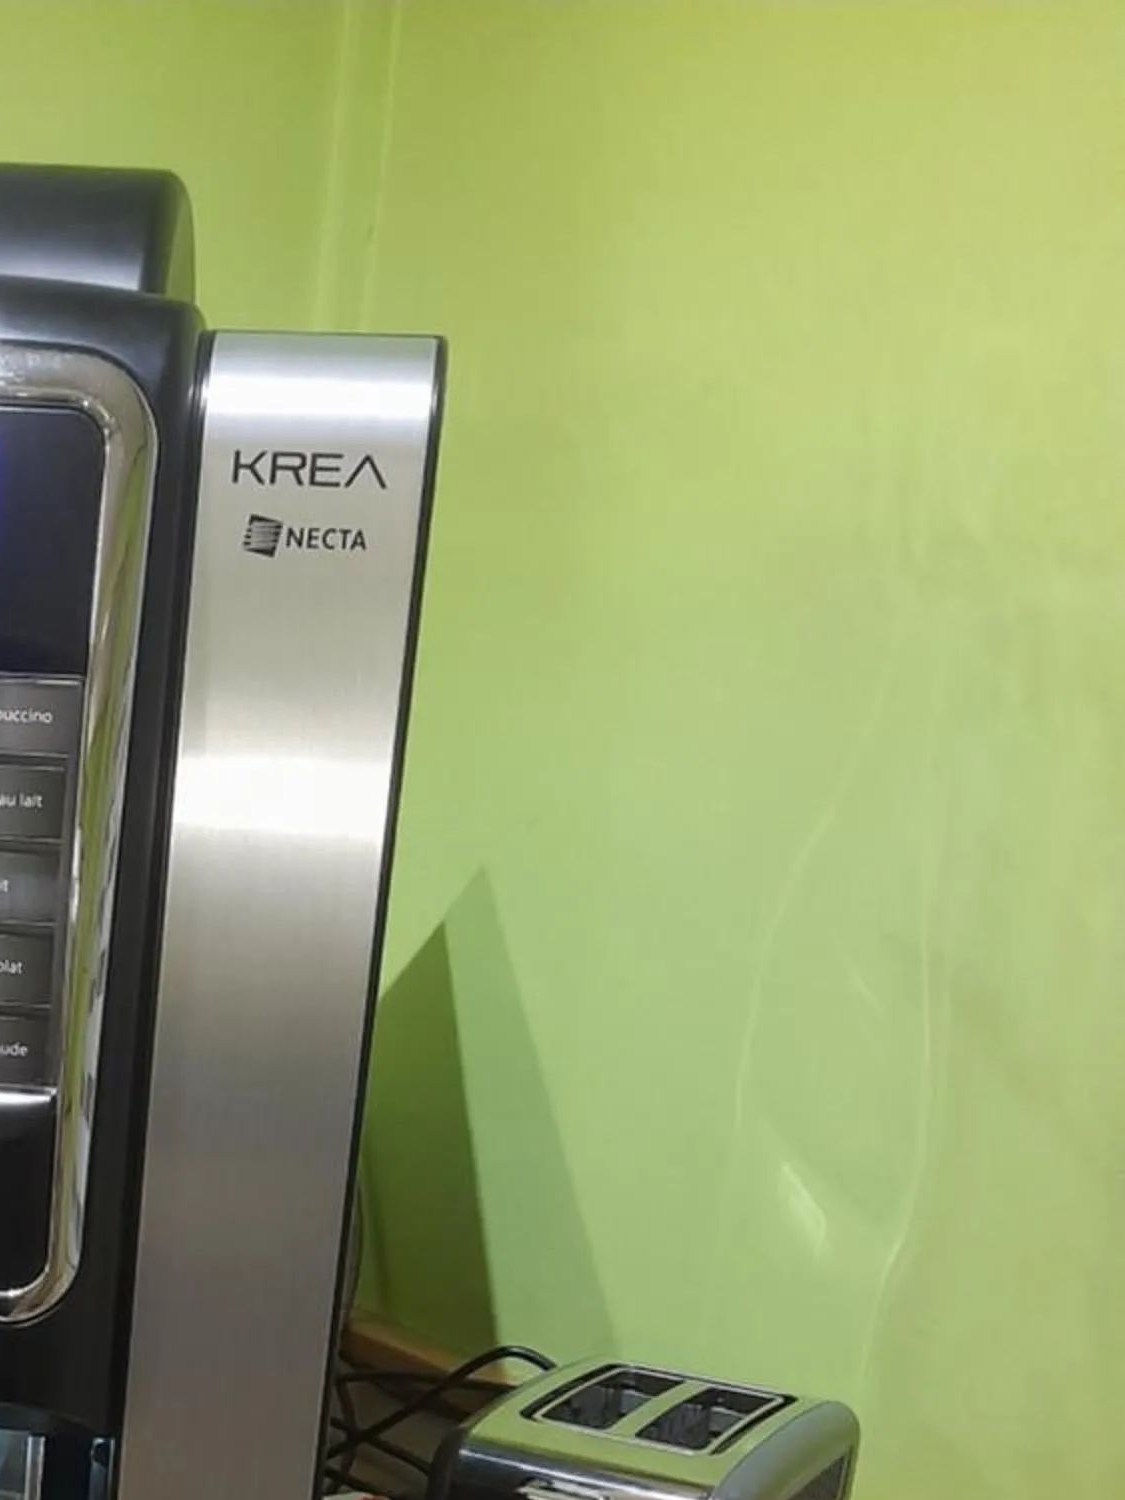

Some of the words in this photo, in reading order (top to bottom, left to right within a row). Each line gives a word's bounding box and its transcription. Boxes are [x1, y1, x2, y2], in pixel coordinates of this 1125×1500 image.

[232, 449, 387, 490] KREA
[286, 527, 367, 551] NECTA
[20, 793, 43, 809] lait
